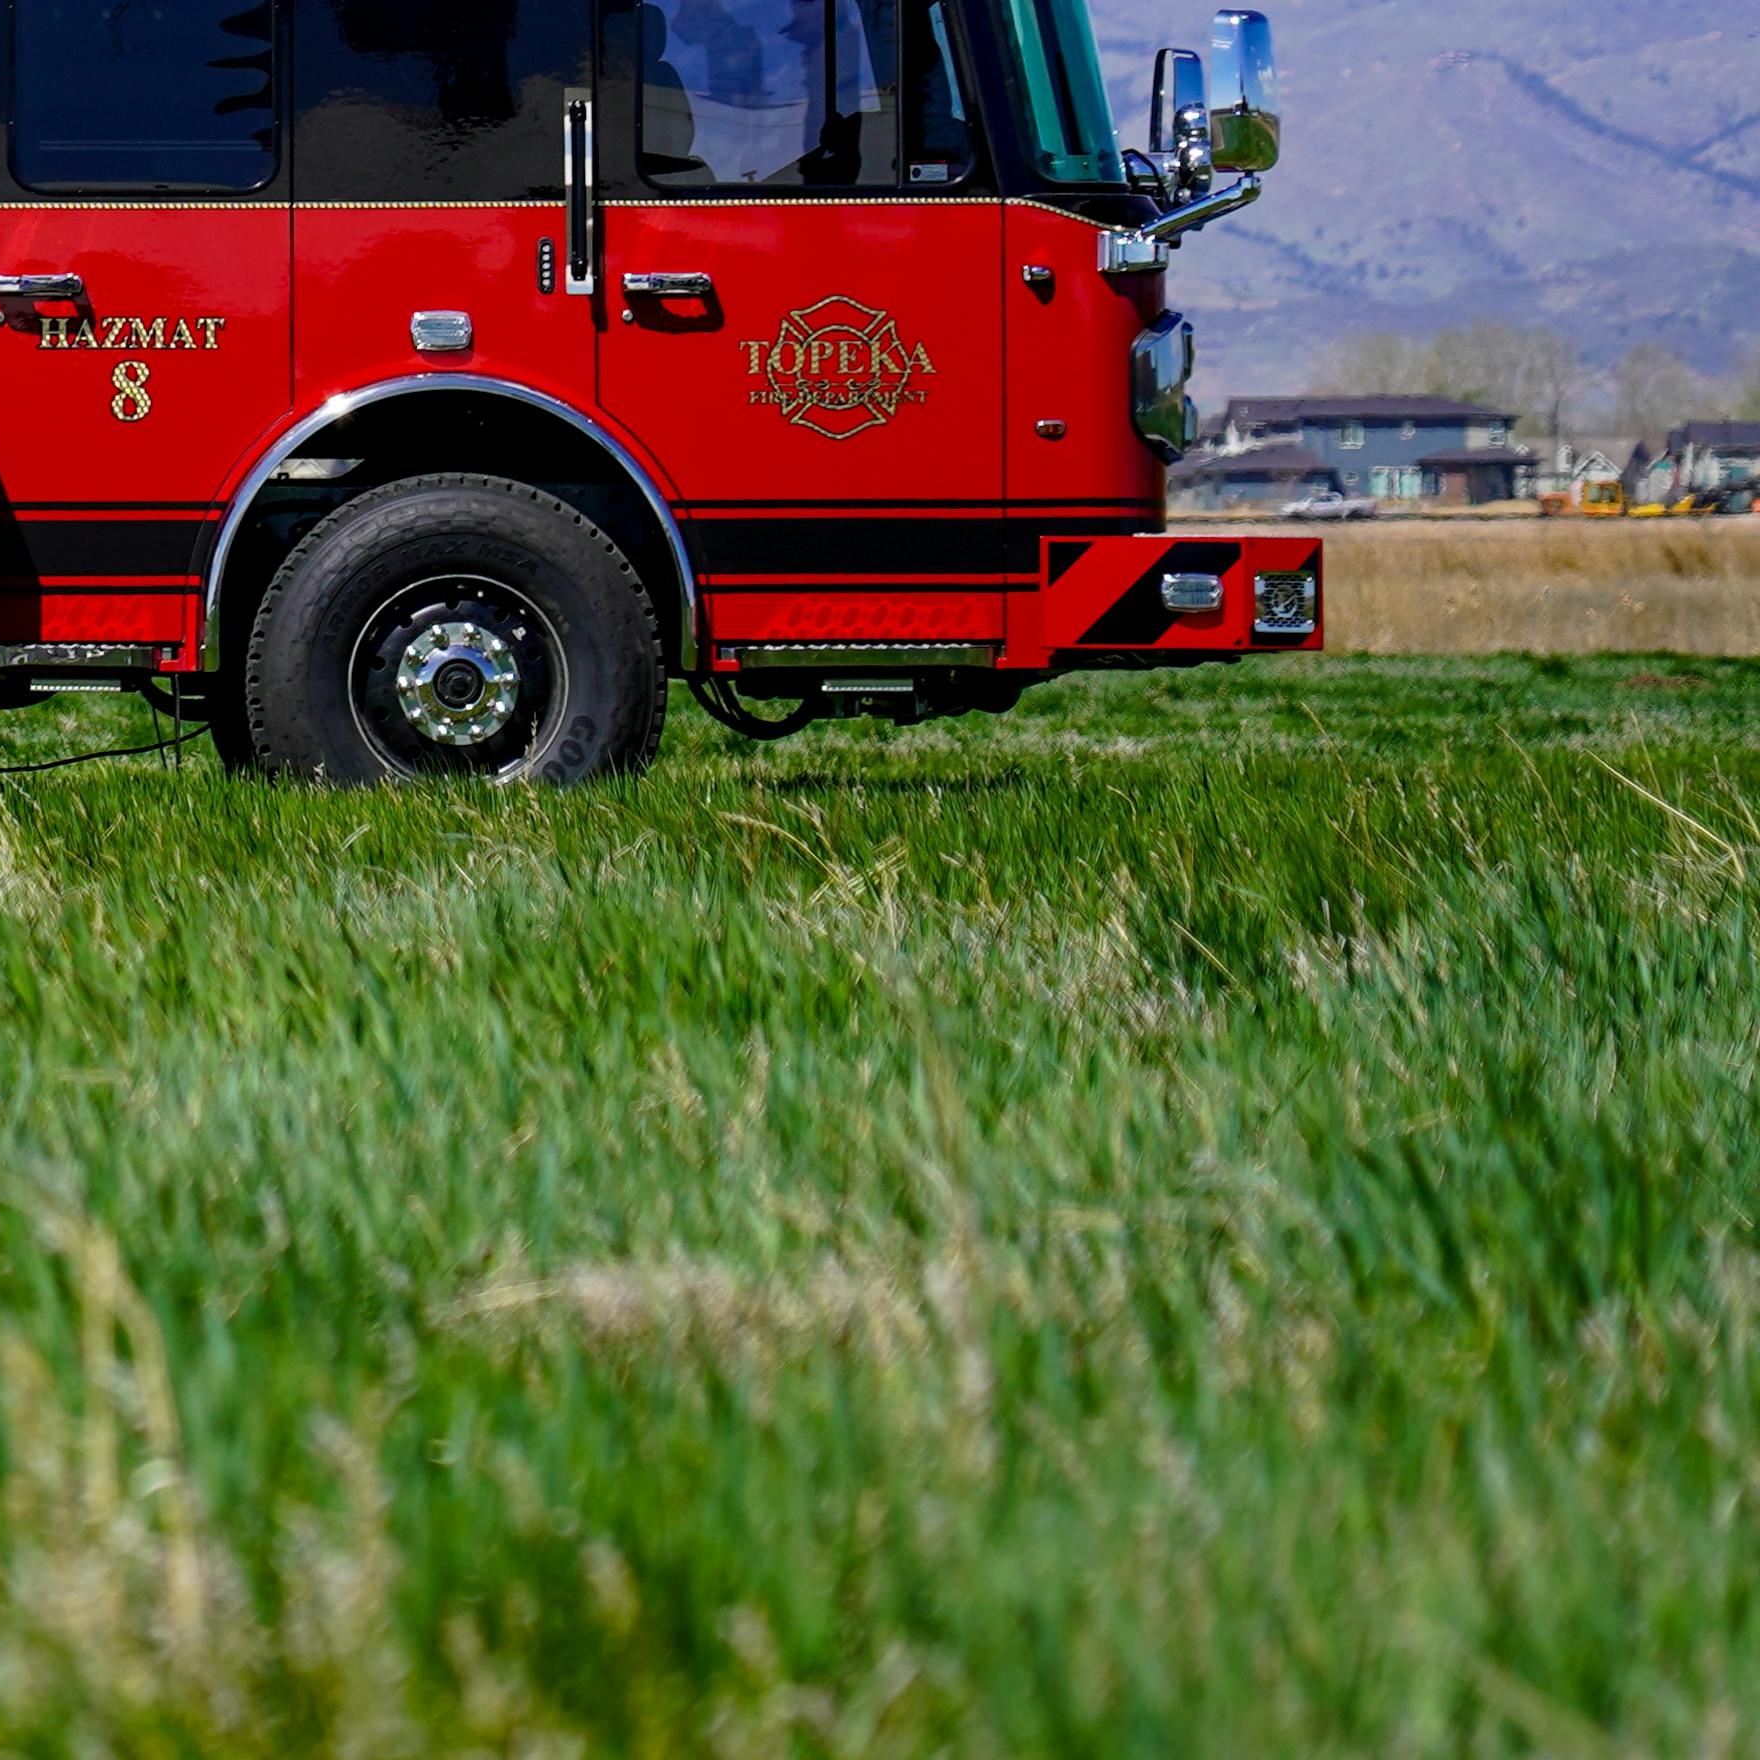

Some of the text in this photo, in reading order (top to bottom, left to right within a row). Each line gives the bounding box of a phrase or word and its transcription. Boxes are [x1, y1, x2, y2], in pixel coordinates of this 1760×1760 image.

[37, 316, 226, 350] HAZMAT
[738, 340, 937, 375] TOPEKA
[110, 360, 153, 421] 8
[749, 390, 929, 404] FIRE DEPARTMENT
[398, 539, 470, 566] MAX
